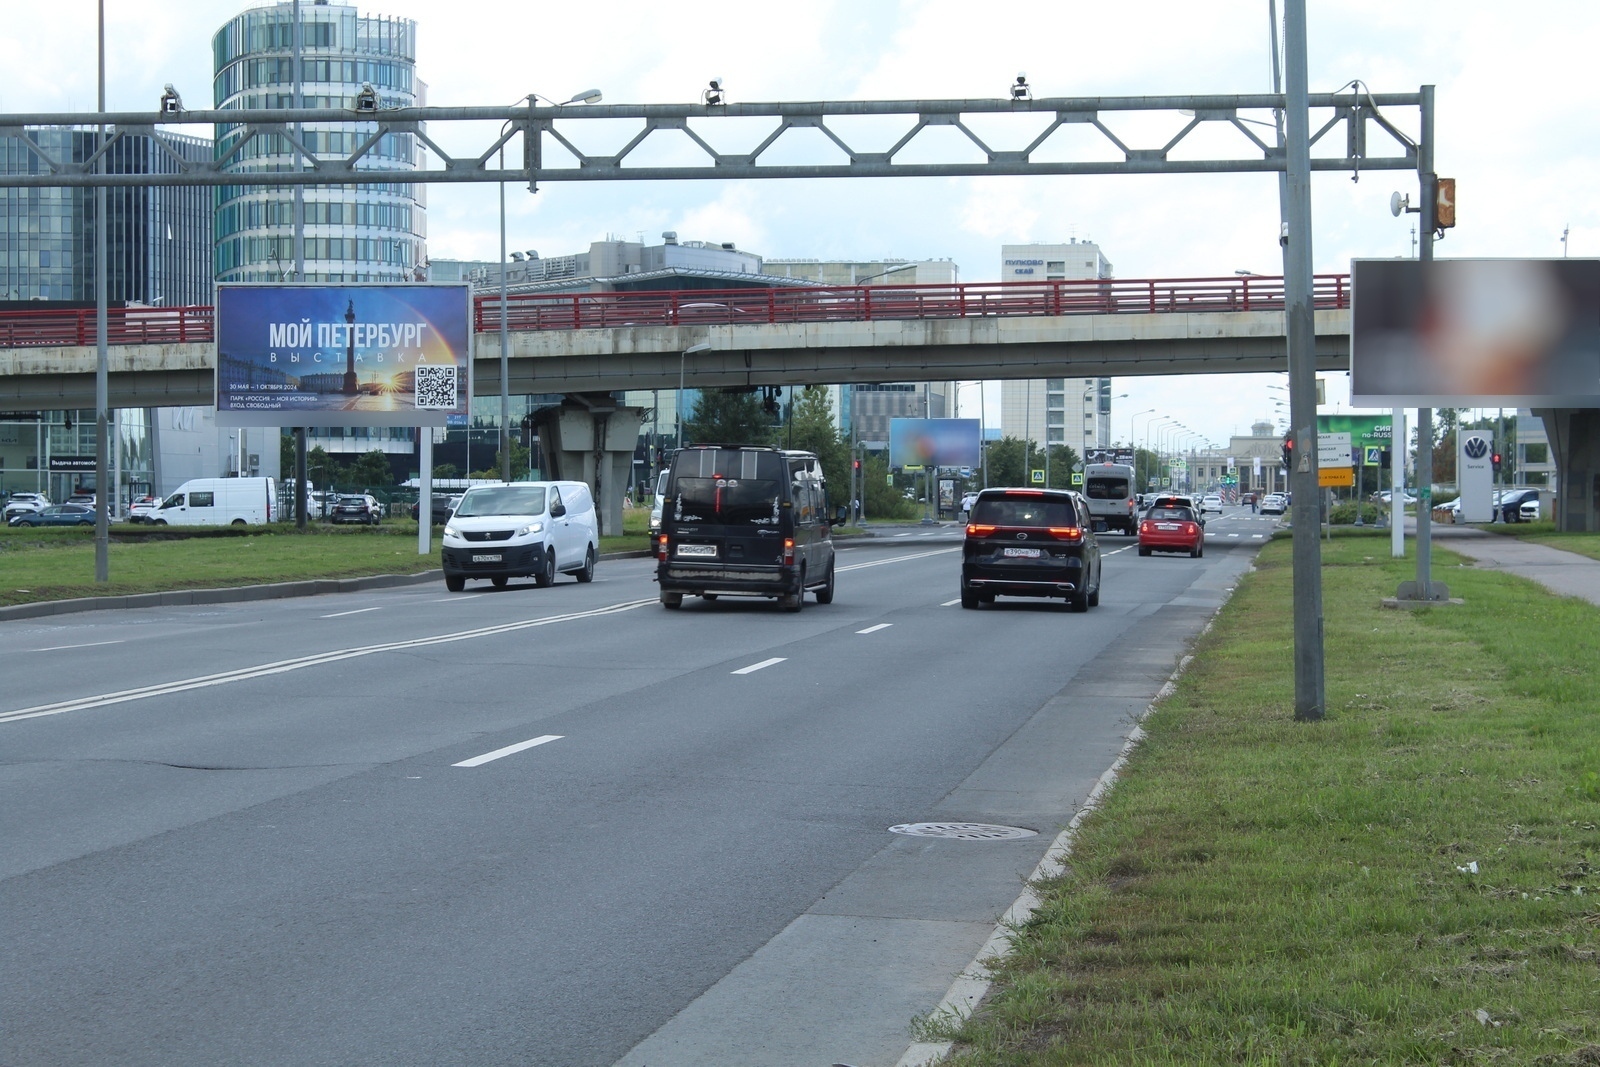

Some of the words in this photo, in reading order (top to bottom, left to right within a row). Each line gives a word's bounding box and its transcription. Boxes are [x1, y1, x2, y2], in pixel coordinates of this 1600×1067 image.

[269, 318, 312, 348] МОЙ
[317, 323, 427, 348] ПЕТЕРБУРГ
[270, 352, 427, 363] ВЫСТАВКА
[246, 401, 282, 409] СВОБОДНЫЙ
[51, 460, 72, 468] Выдача
